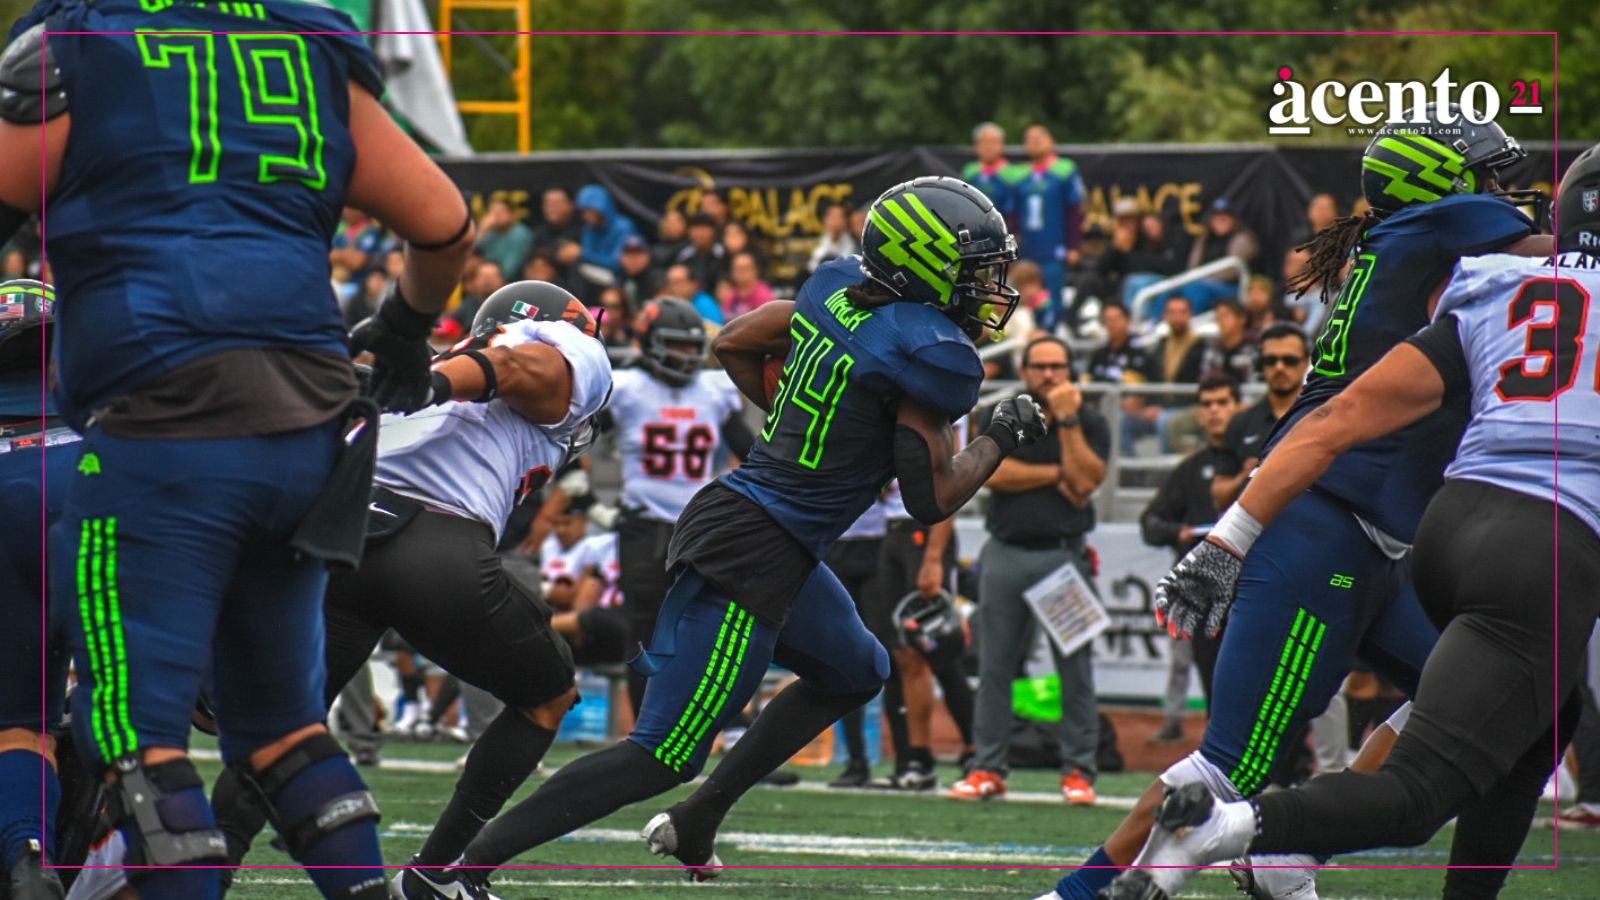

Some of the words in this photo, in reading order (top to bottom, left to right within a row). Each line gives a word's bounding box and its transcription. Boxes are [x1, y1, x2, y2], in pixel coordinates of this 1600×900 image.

[134, 28, 326, 190] 79
[1026, 194, 1045, 231] 1
[1494, 277, 1600, 403] 3
[642, 422, 714, 482] 56
